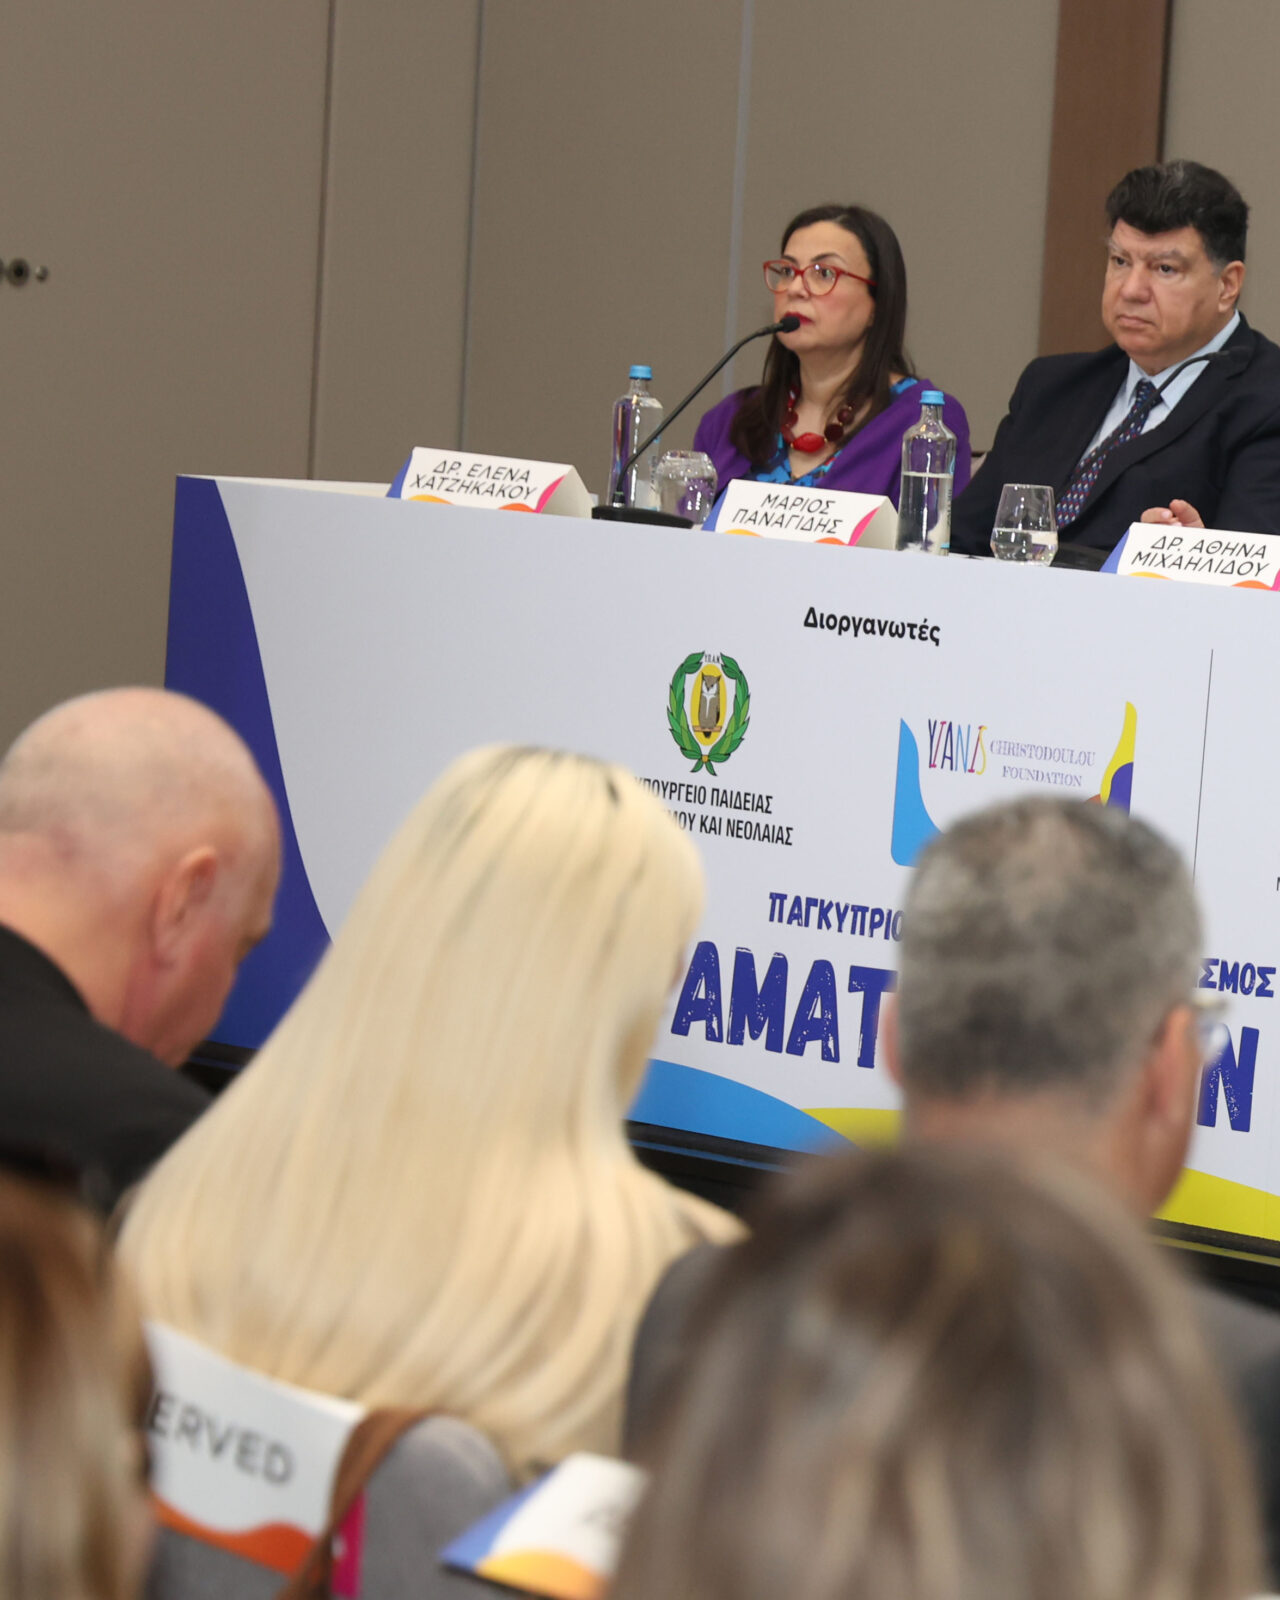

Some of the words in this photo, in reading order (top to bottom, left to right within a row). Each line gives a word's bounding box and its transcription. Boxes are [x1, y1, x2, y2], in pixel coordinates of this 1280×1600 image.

[433, 460, 461, 475] ΔΡ.
[467, 463, 530, 483] ΕΛΕΝΑ
[410, 474, 538, 500] ΧΑΤΖΗΚΑΚΟΥ
[760, 493, 836, 515] ΜΑΡΙΟΣ
[731, 508, 843, 534] ΠΑΝΑΓΙΔΗΣ
[1151, 536, 1183, 552] ΔΡ.
[1189, 539, 1267, 559] ΑΘΗΝΑ
[1131, 551, 1270, 577] ΜΙΧΑΗΛΙΔΟΥ
[803, 606, 941, 647] Διοργανωτές
[990, 740, 1096, 767] CHRISTODOULOU
[1002, 765, 1083, 787] FOUNDATION
[710, 787, 773, 814] ΠΑΙΔΕΙΑΣ
[699, 814, 722, 836] ΚΑΙ
[726, 818, 794, 846] ΝΕΟΛΑΙΑΣ
[769, 892, 905, 942] ΠΑΓΚΥΠΡΙΟ
[1198, 958, 1276, 998] ΣΜΟΣ
[671, 940, 899, 1069] ΑΜΑΤ
[1197, 1023, 1260, 1132] Ν
[148, 1393, 294, 1486] ERVED
